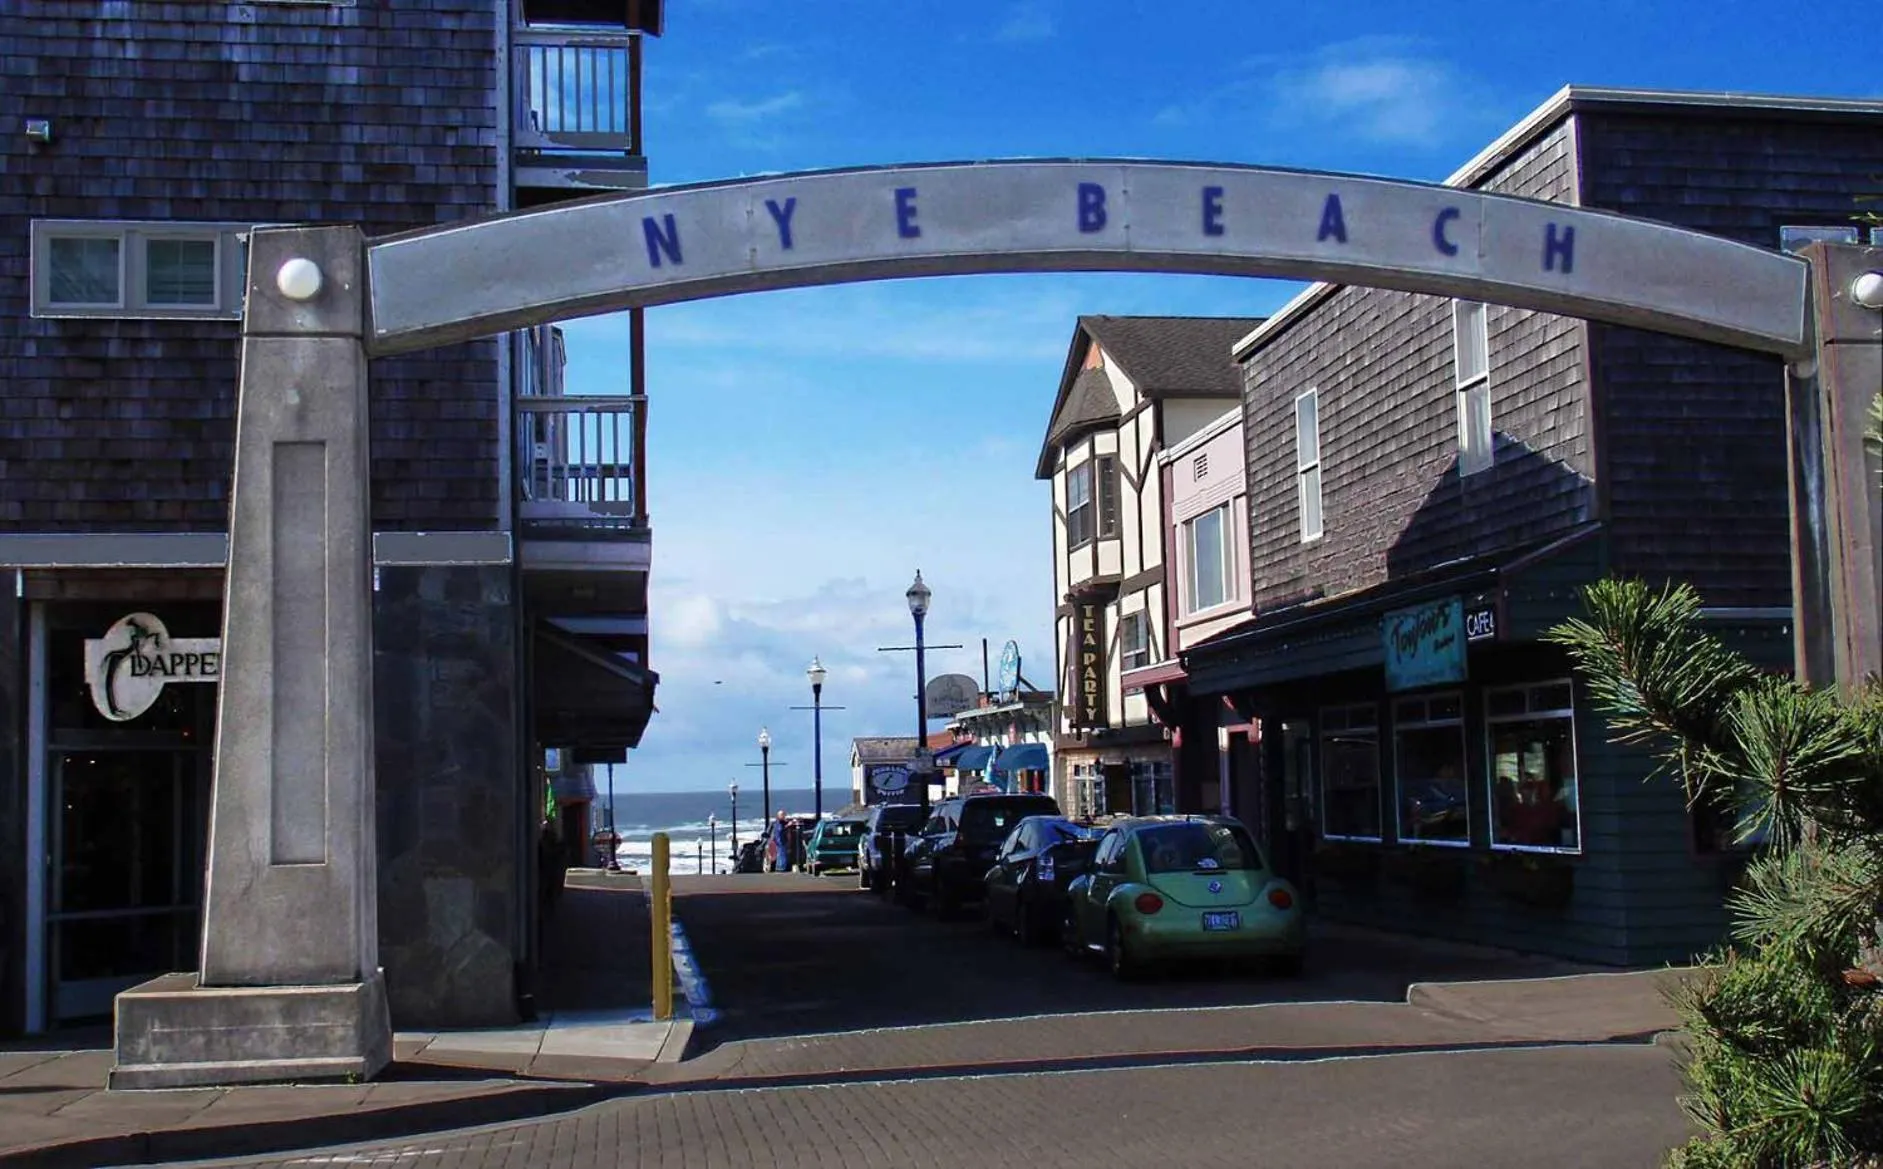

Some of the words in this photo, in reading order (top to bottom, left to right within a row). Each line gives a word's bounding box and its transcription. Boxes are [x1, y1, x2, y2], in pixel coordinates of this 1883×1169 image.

[642, 186, 920, 268] NYE
[1077, 182, 1575, 273] BEACH
[1082, 604, 1096, 645] TEA
[130, 653, 221, 677] DAPPE
[1083, 653, 1098, 721] PARTY
